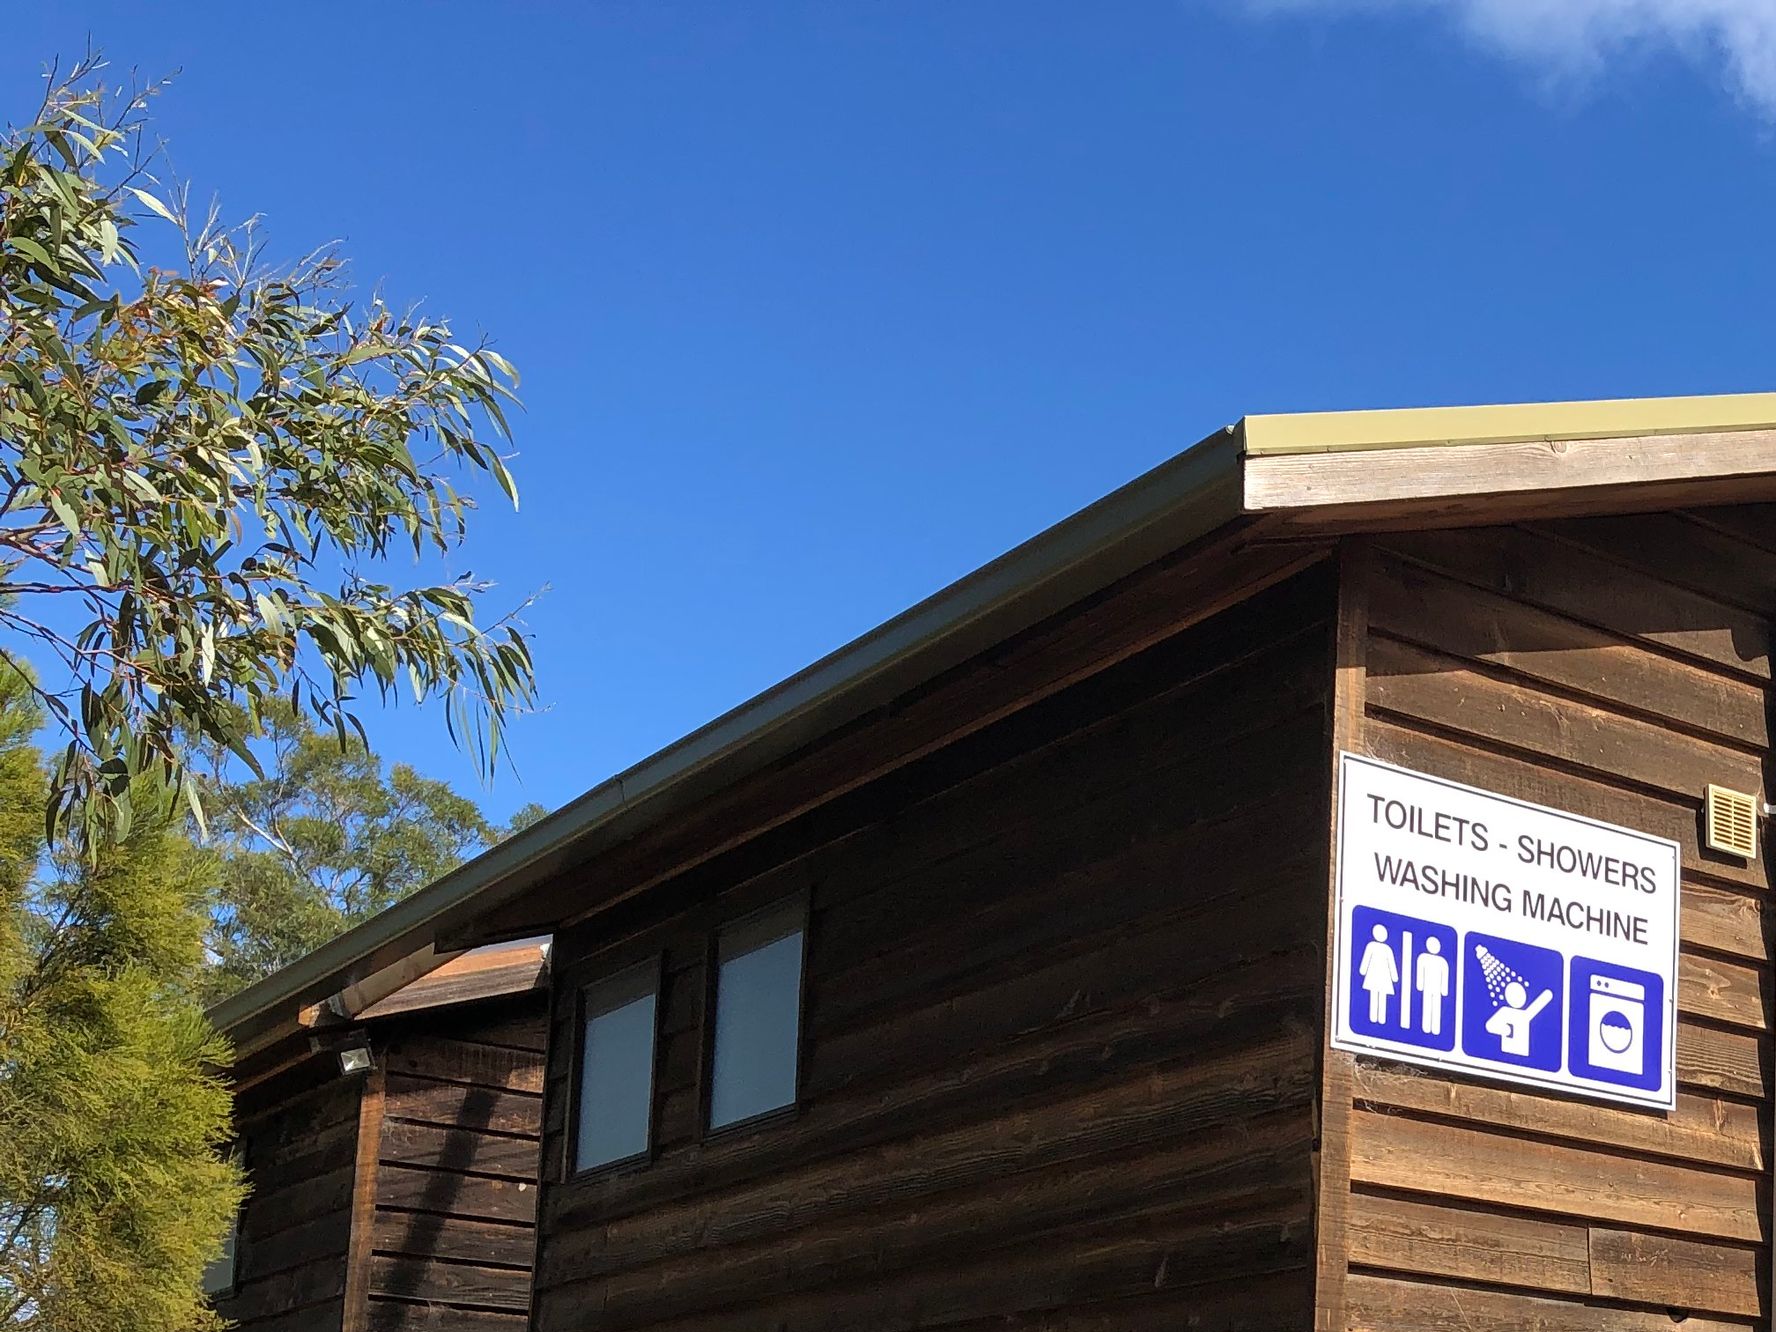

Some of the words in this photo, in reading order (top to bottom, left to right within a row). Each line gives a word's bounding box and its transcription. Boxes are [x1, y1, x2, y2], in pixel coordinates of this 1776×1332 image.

[1366, 793, 1489, 852] TOILETS
[1517, 834, 1657, 894] SHOWERS
[1374, 852, 1512, 913] WASHING
[1522, 889, 1648, 946] MACHINE
